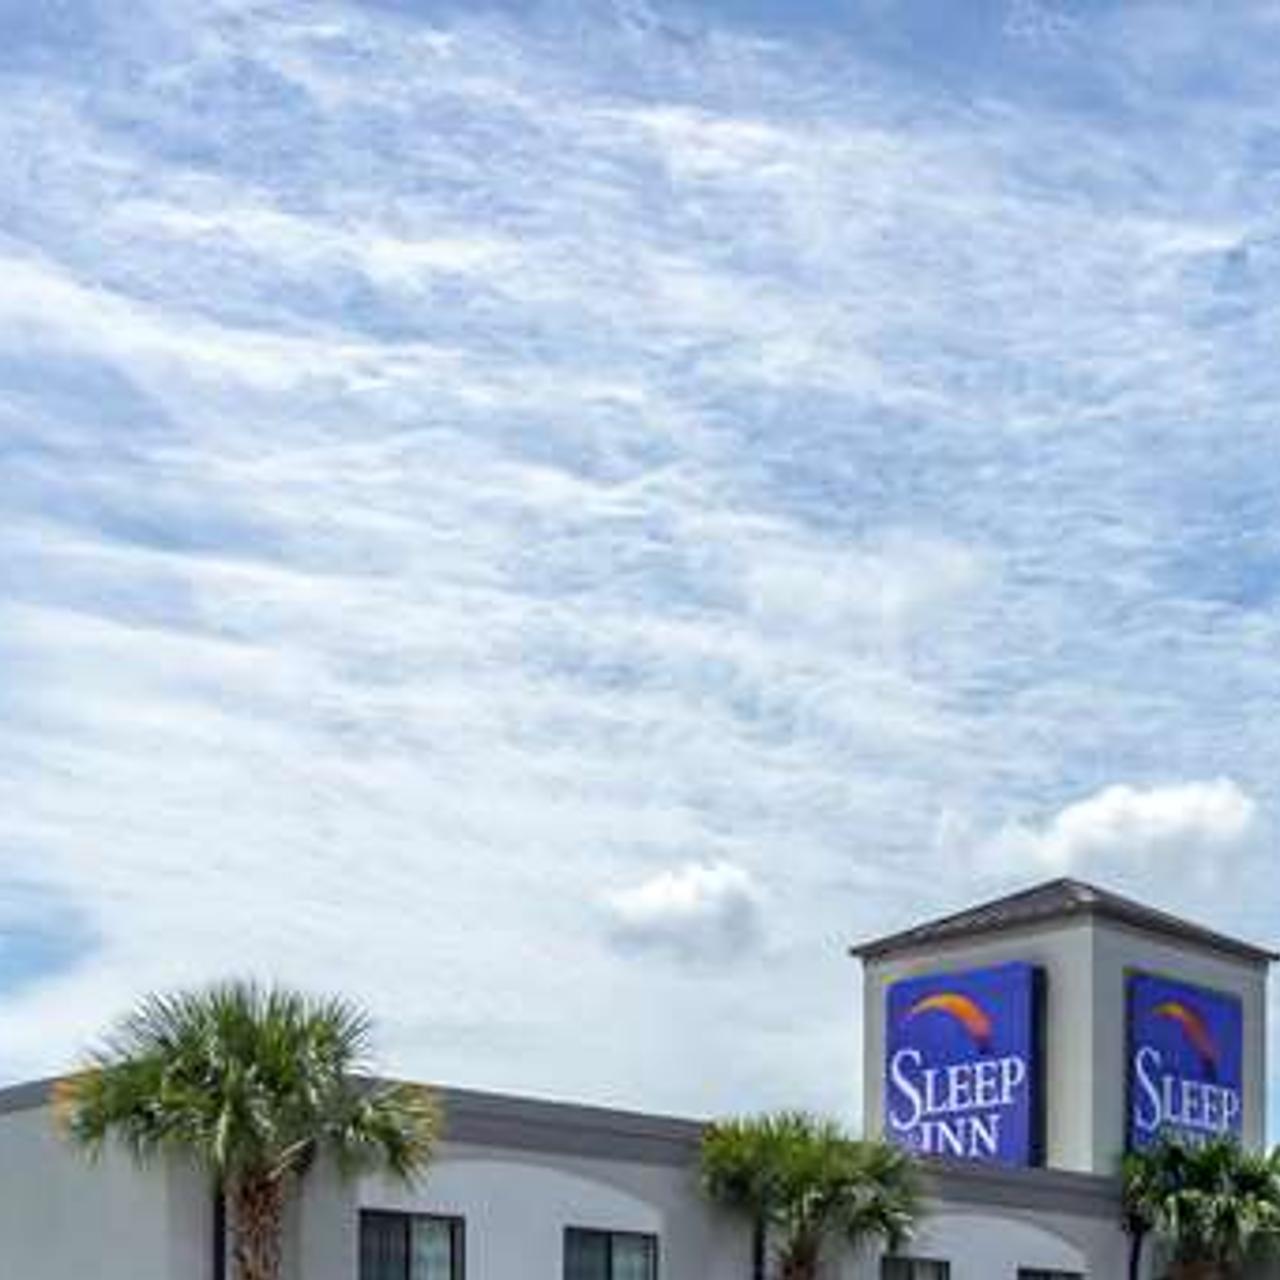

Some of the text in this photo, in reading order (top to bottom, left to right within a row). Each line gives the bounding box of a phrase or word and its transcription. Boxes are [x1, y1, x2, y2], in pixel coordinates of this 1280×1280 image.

[890, 1049, 1025, 1130] SLEEP
[1134, 1046, 1240, 1132] SLEEP
[921, 1114, 1001, 1155] INN
